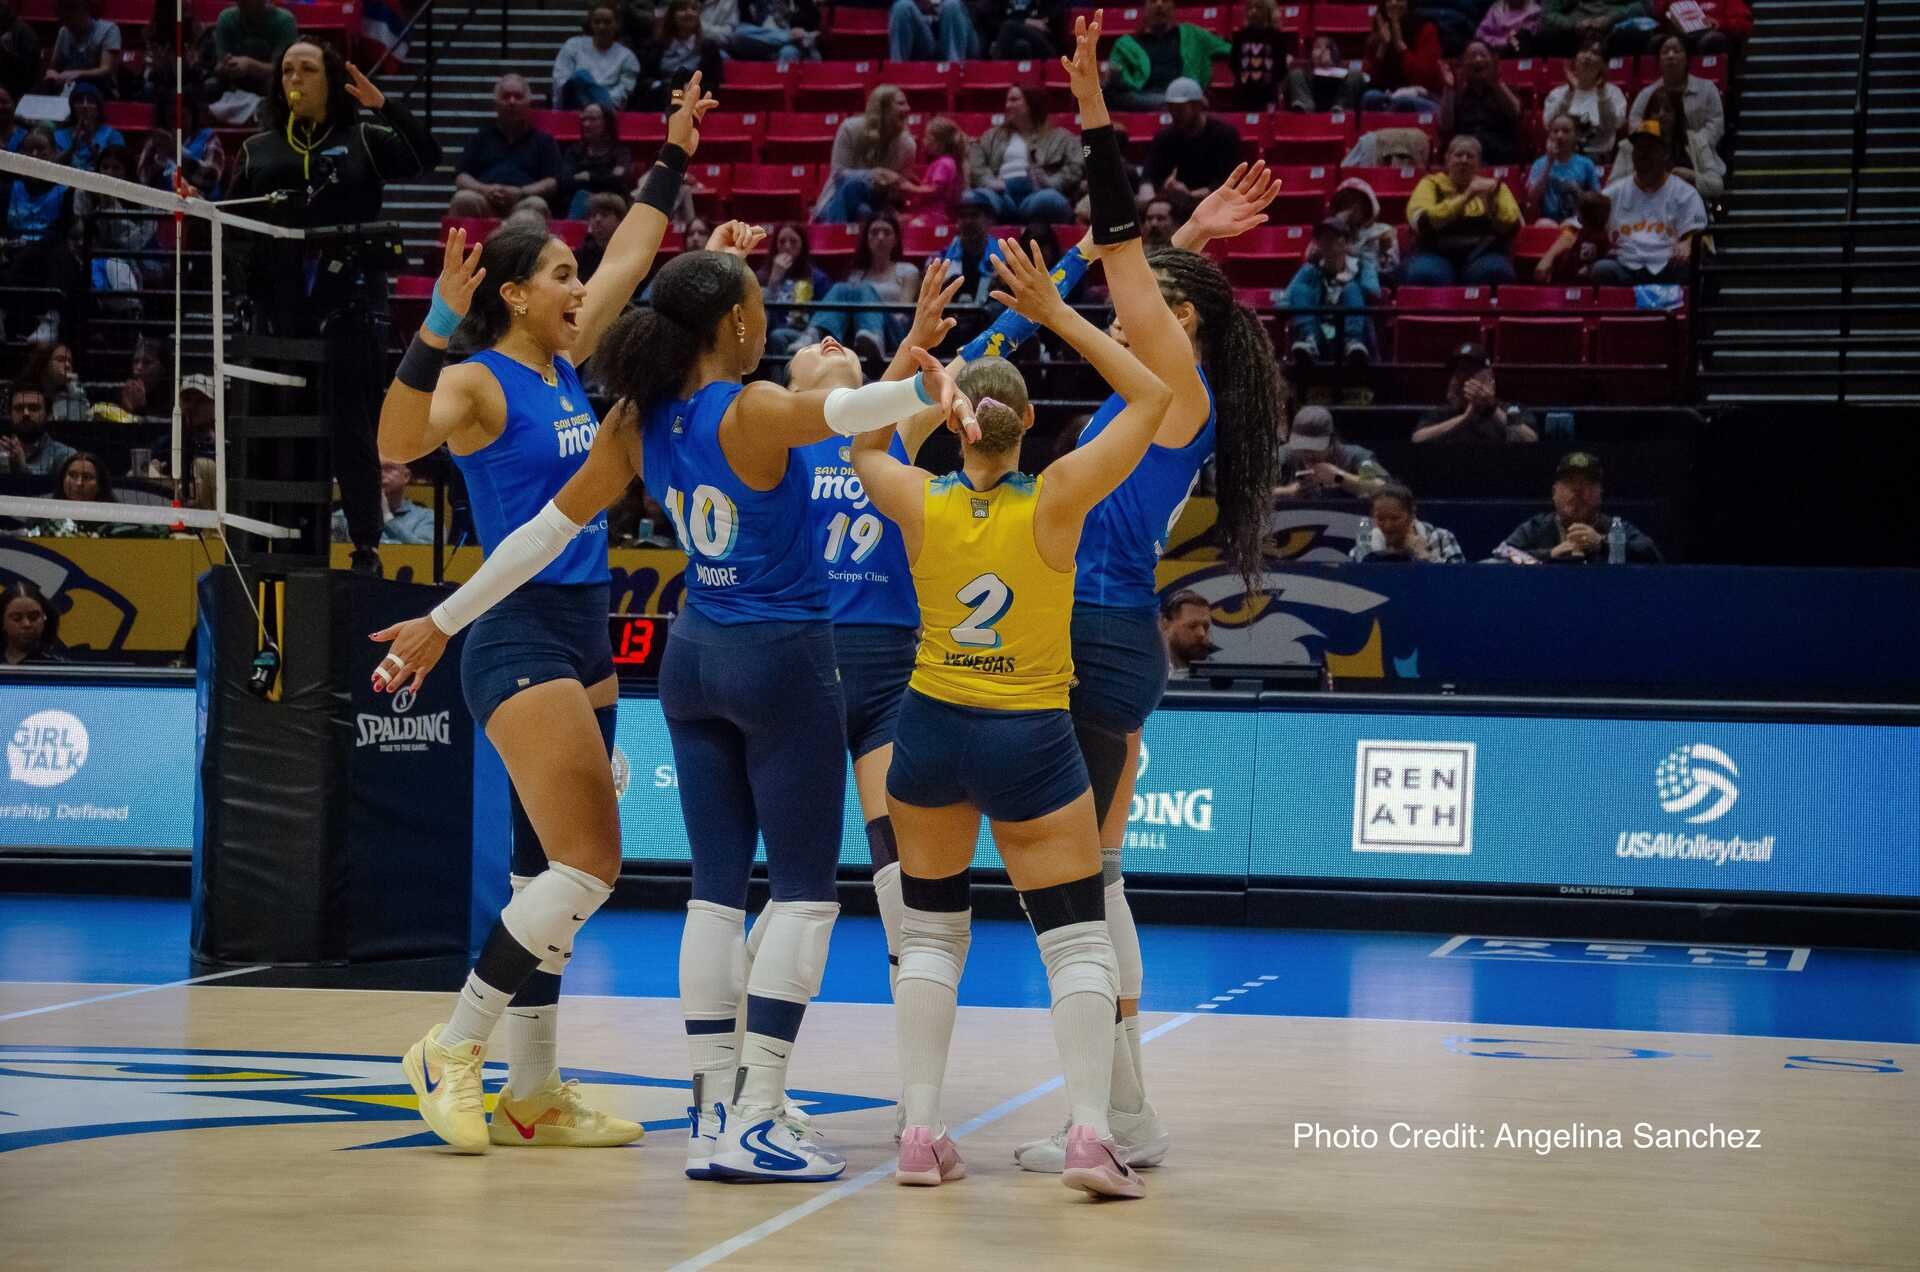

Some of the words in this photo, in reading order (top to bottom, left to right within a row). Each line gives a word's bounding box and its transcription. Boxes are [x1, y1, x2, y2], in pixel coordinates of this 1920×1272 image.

[554, 418, 572, 432] SAN
[570, 412, 591, 426] DIEGO
[814, 466, 837, 475] SAN
[664, 484, 739, 560] 10
[823, 511, 883, 564] 19
[695, 562, 740, 587] MOORE
[828, 570, 863, 583] Scripps
[865, 571, 889, 583] Clinic
[949, 572, 1015, 650] 2
[620, 619, 654, 658] 13
[944, 652, 1016, 673] VENEGAS
[12, 726, 74, 749] GIRL
[356, 710, 452, 748] SPALDING
[22, 749, 84, 770] TALK
[1372, 766, 1456, 791] REN
[56, 801, 129, 820] Defined
[1369, 802, 1457, 827] ATH
[1559, 886, 1634, 896] DAKTRONICS
